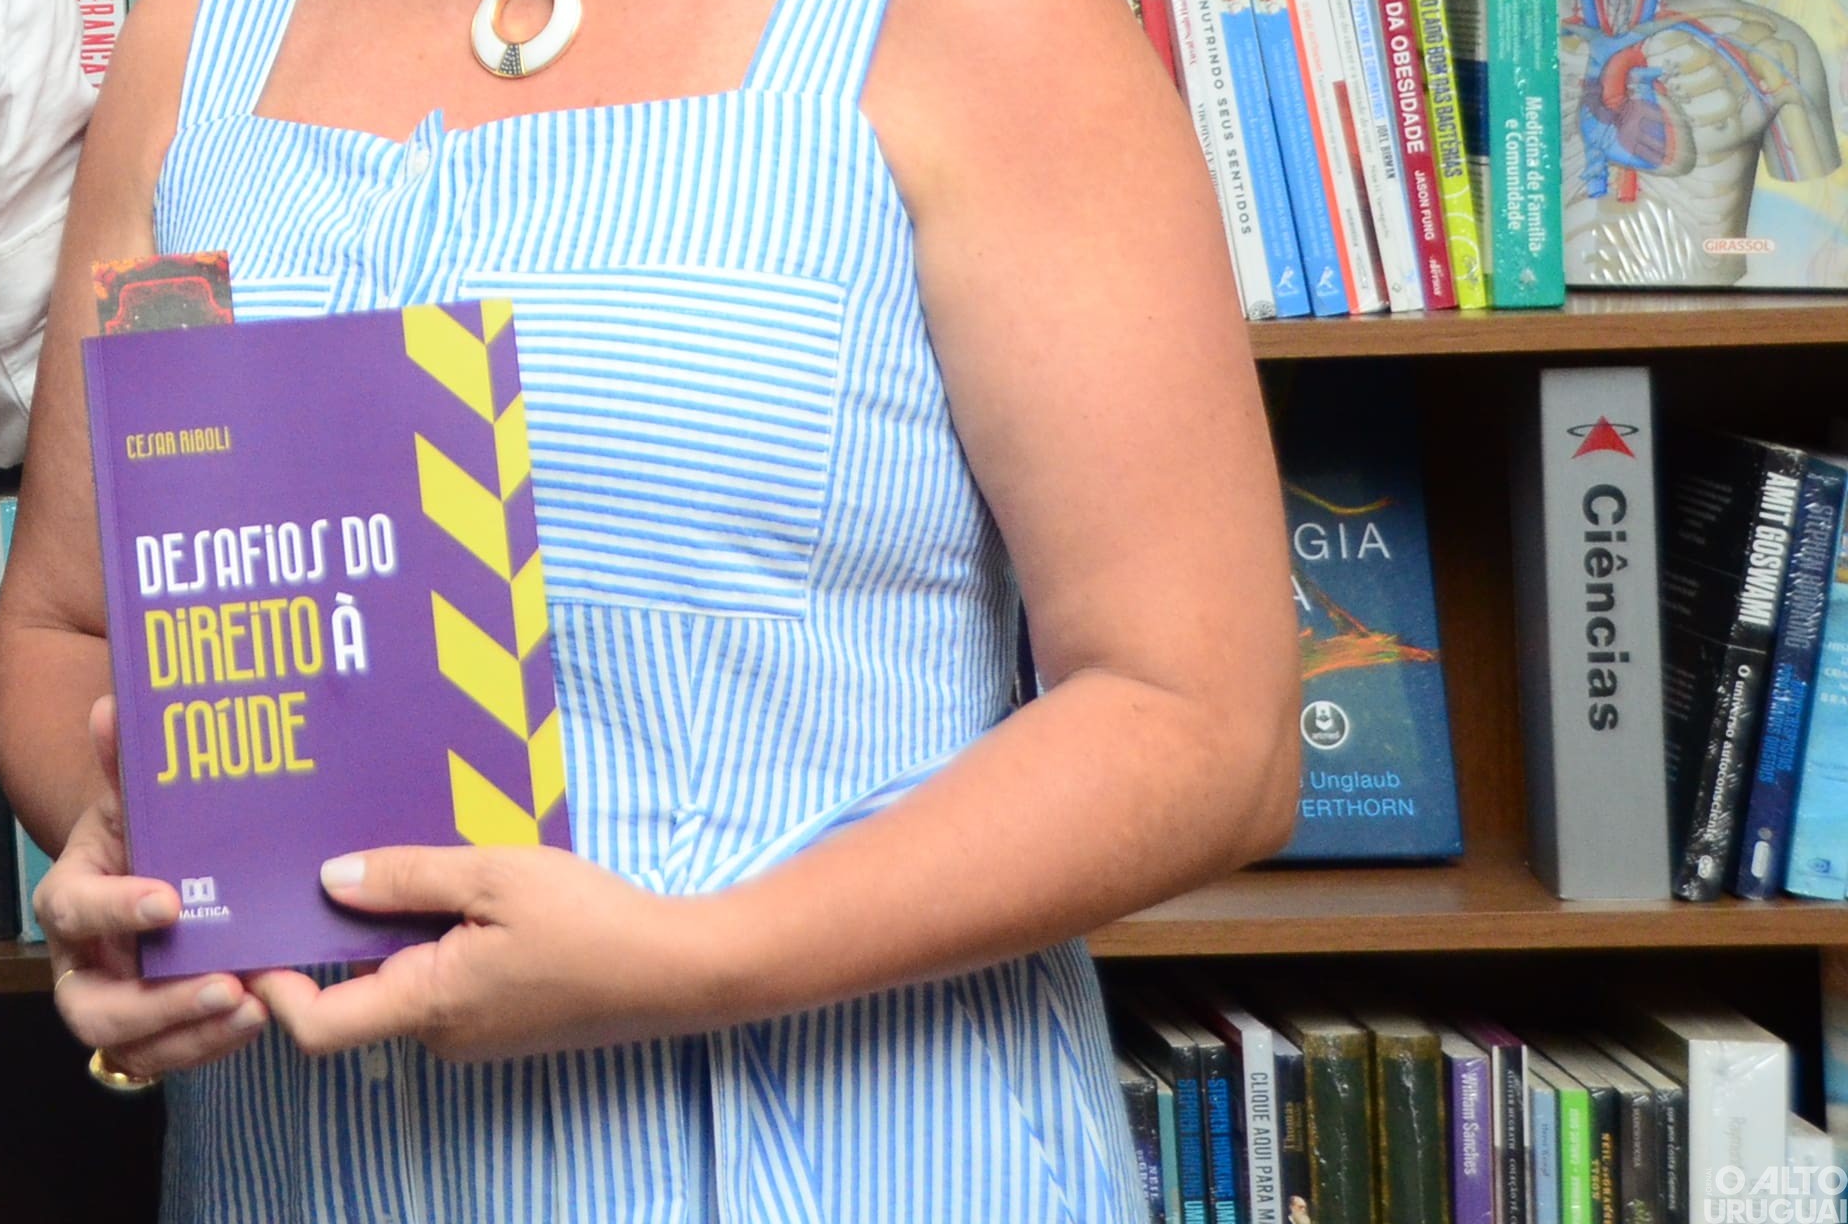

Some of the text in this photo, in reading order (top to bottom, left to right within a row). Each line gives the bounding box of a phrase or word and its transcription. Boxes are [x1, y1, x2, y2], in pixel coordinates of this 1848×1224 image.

[1385, 2, 1404, 30] DA
[1198, 0, 1252, 236] NUTRINDO SEUS SENTIDOS
[1390, 34, 1426, 154] OBESIDADE
[1415, 170, 1430, 206] JASON
[1524, 95, 1542, 252] Medicina de Família
[1421, 208, 1434, 240] FUNG
[1704, 239, 1771, 252] GIRASSOL
[125, 433, 176, 459] CESAR
[342, 512, 396, 576] DO
[1293, 522, 1391, 560] GIA
[1738, 471, 1799, 627] AMIT GOSWAMI
[333, 594, 367, 672] À
[1581, 484, 1631, 732] Ciências
[156, 691, 316, 783] SAÚDE
[1311, 771, 1400, 790] Unglaub
[1207, 1078, 1233, 1199] STEPHEN HAWKING
[1251, 1072, 1273, 1203] CLIQUE AQUI PARA
[1461, 1071, 1480, 1176] William Sanches
